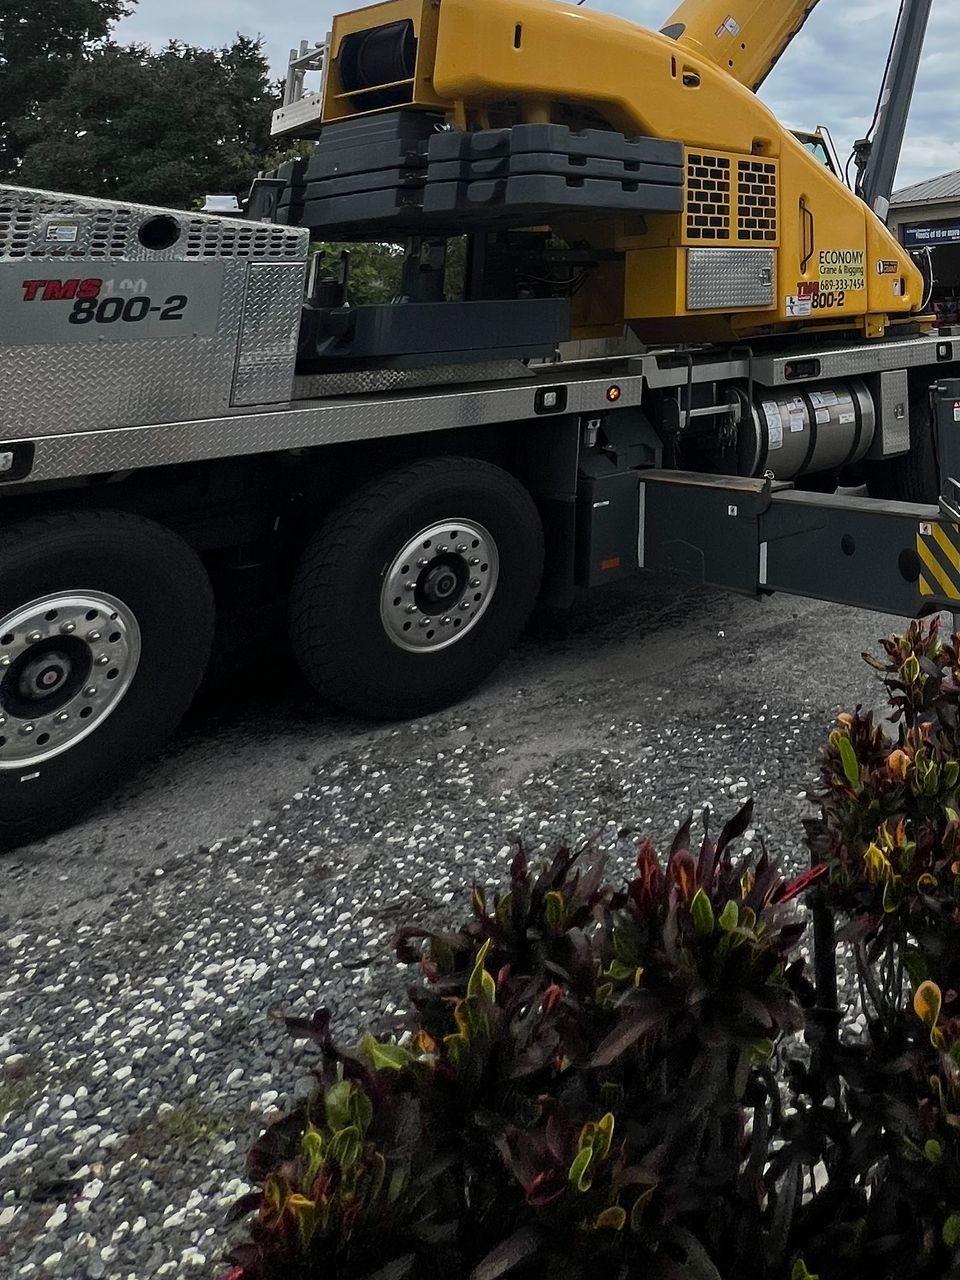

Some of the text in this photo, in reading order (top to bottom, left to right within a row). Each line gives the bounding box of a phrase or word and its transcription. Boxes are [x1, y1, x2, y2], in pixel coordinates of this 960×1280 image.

[819, 251, 864, 264] ECONOMY
[820, 265, 864, 276] Crane & Rigging
[22, 278, 103, 301] TMS
[820, 279, 864, 291] 689-333-7454
[811, 291, 845, 308] 800-2
[68, 294, 188, 325] 800-2
